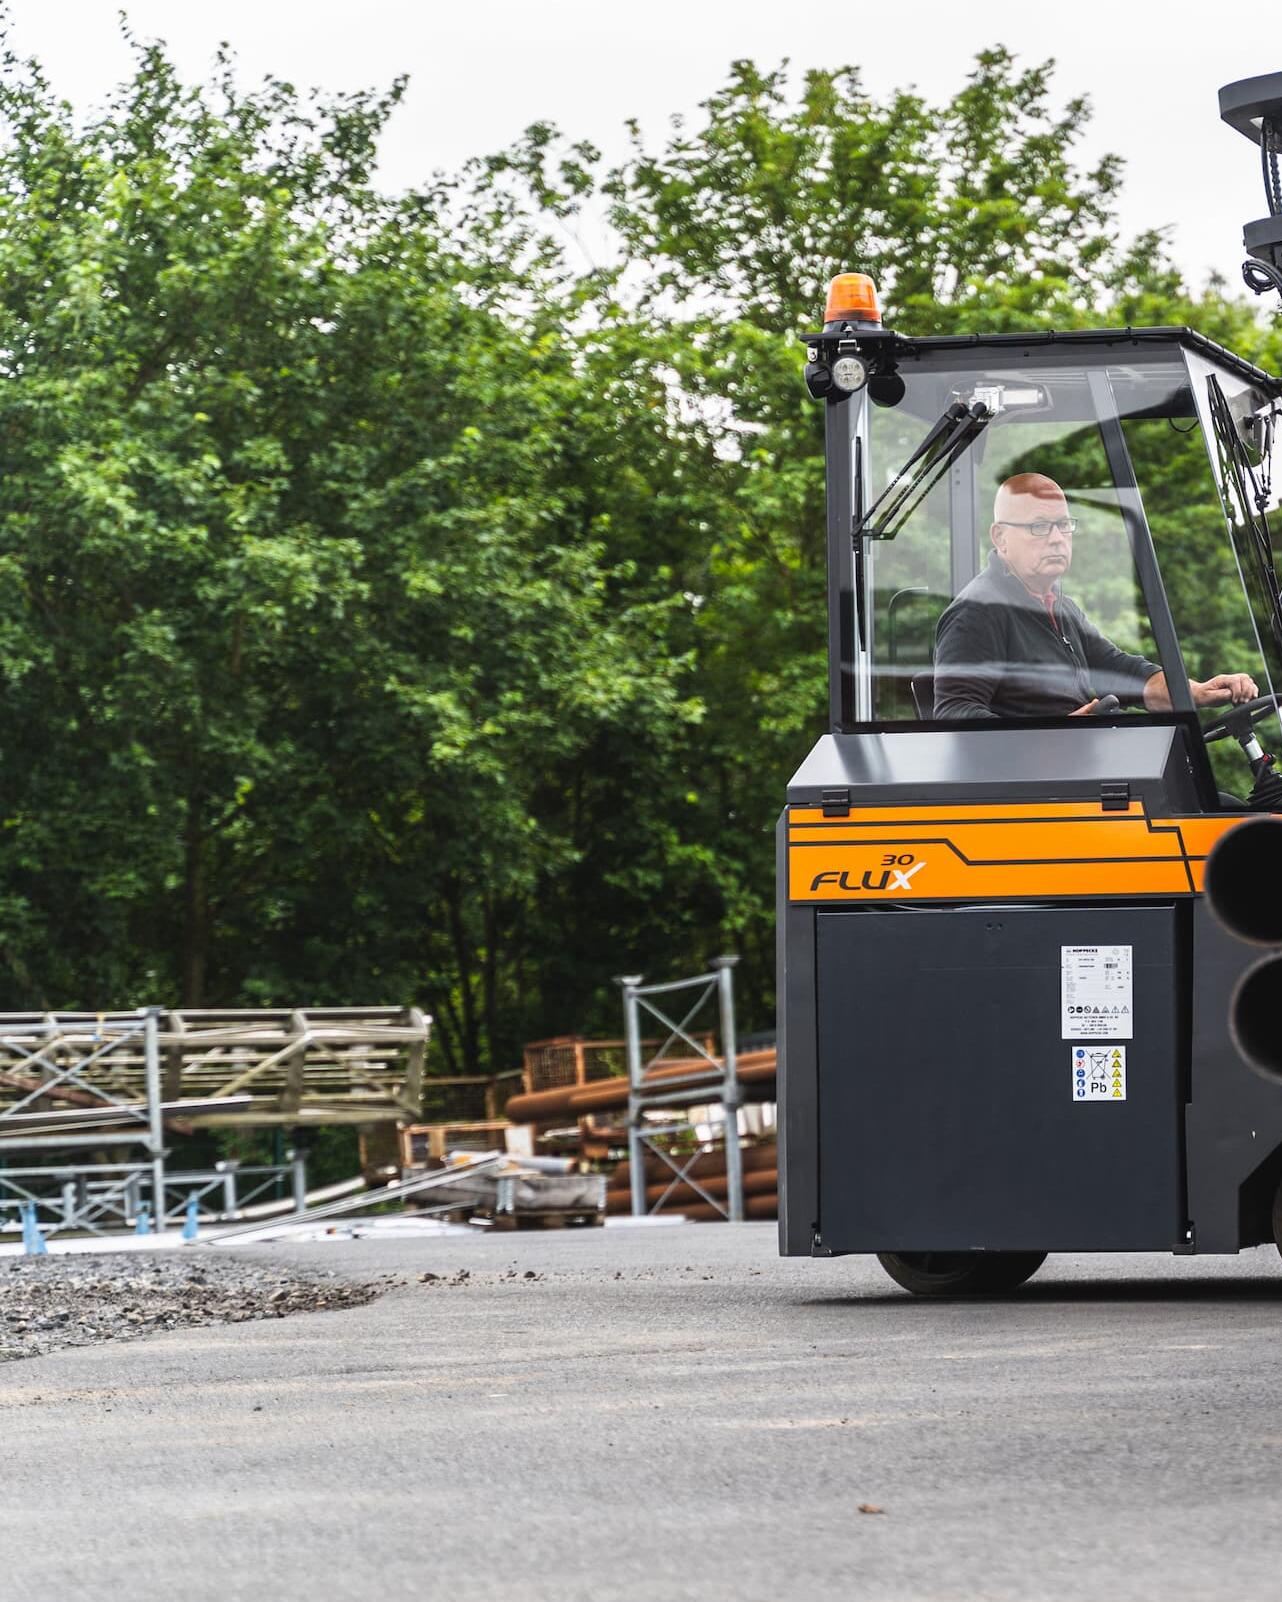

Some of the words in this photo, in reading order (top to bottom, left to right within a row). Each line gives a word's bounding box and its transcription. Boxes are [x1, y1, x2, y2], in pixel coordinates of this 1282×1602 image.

[880, 854, 915, 866] 30
[810, 862, 927, 891] FLUX
[1091, 1082, 1107, 1093] Pb
